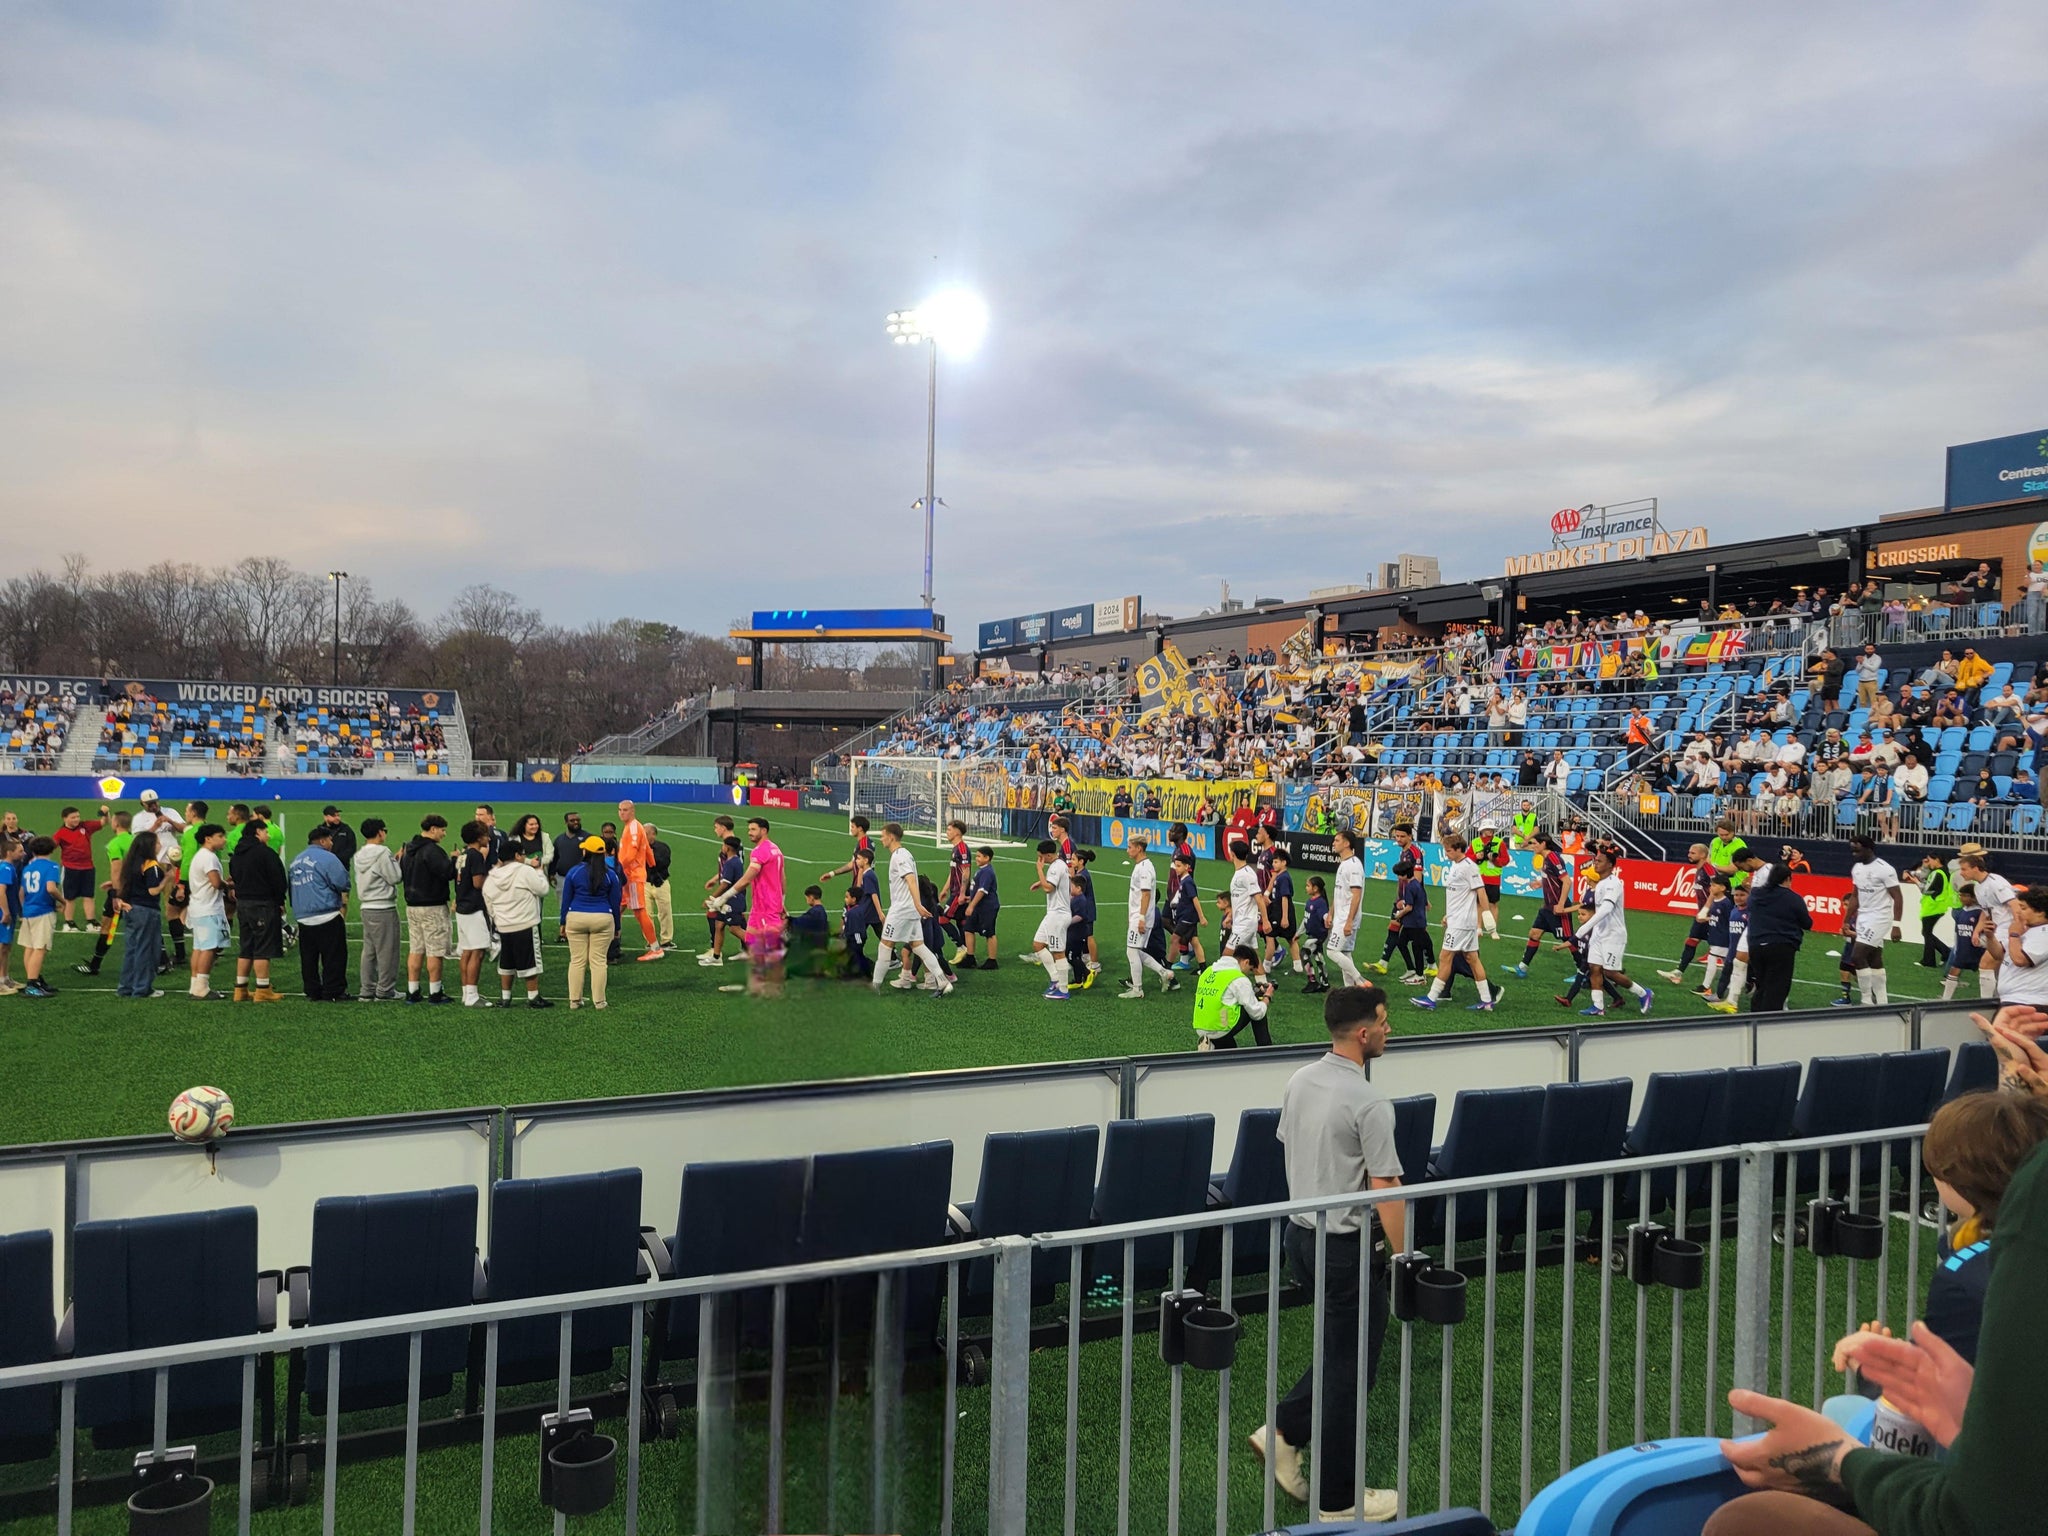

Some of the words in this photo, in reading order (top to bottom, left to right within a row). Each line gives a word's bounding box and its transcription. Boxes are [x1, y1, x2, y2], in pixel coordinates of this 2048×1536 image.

[1553, 511, 1580, 533] AAA
[1581, 517, 1651, 539] Insurance
[1505, 541, 1613, 576] MARKET
[1617, 527, 1708, 561] PLAZA
[1878, 544, 1960, 568] CROSSBAR
[1103, 604, 1119, 616] 2024
[59, 681, 91, 697] FC
[178, 684, 257, 704] WICKED
[263, 686, 313, 705] GOOD
[318, 688, 389, 707] SOCCER
[1343, 788, 1373, 800] DEFIANCE
[1642, 799, 1656, 810] 114
[1166, 829, 1206, 851] NON
[1302, 843, 1309, 851] AN
[1309, 844, 1330, 853] OFFICIAL
[1302, 852, 1309, 861] OF
[1309, 853, 1326, 863] RHODE
[1327, 855, 1341, 864] ISLAN
[23, 871, 41, 893] 13
[1634, 881, 1658, 892] SINCE
[1804, 895, 1841, 915] GER
[1875, 1424, 1929, 1457] odelo
